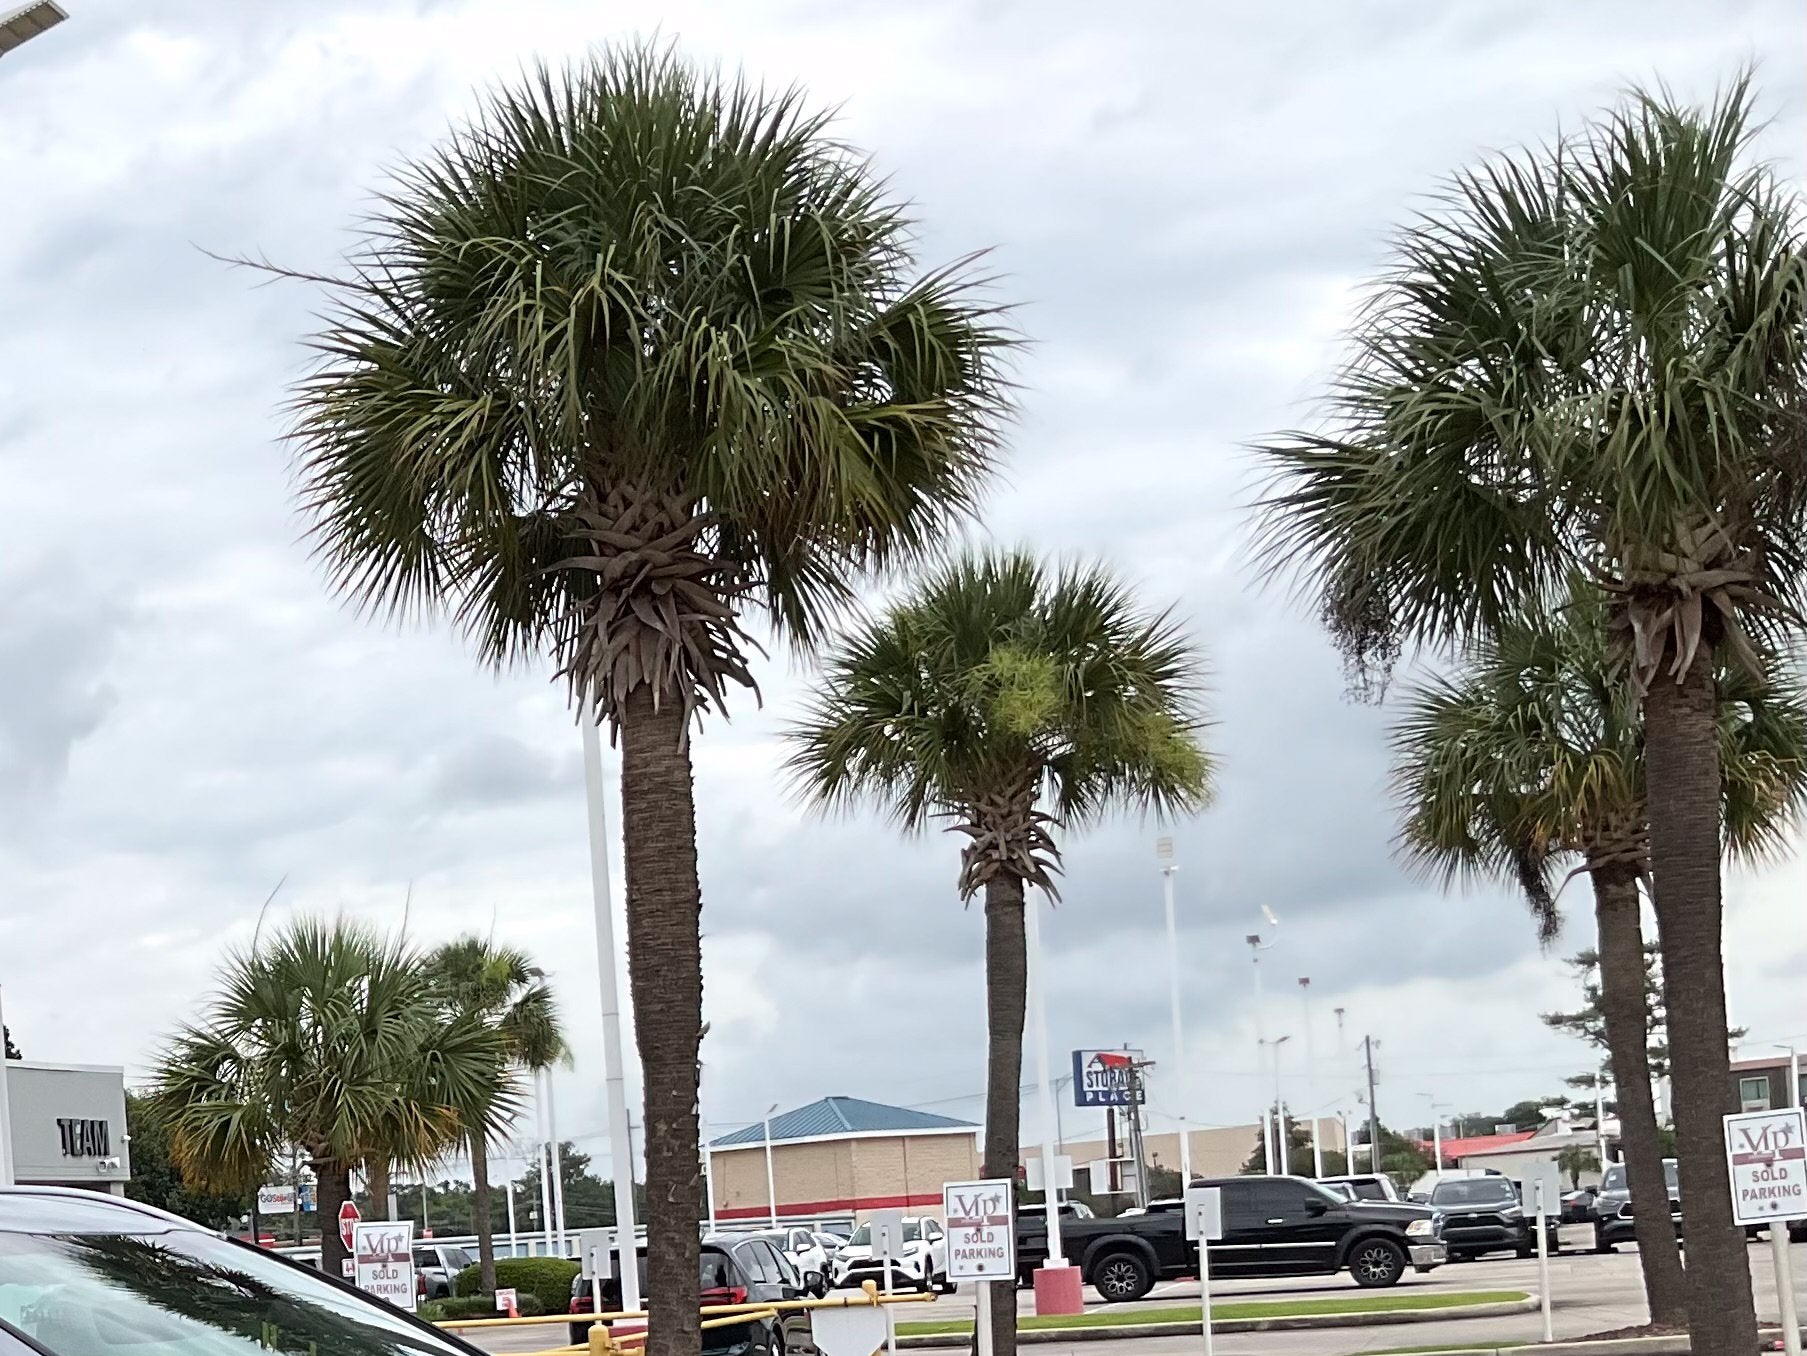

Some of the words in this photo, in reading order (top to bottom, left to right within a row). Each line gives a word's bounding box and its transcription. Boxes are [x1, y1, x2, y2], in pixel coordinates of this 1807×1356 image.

[1085, 1091, 1143, 1102] PLACE
[57, 1118, 111, 1156] TEAM
[1751, 1168, 1788, 1183] SOLD
[1741, 1184, 1802, 1201] PARKING
[963, 1231, 995, 1244] SOLD
[954, 1247, 1005, 1260] PARKING
[371, 1269, 399, 1280] SOLD
[364, 1283, 408, 1295] PARKING
